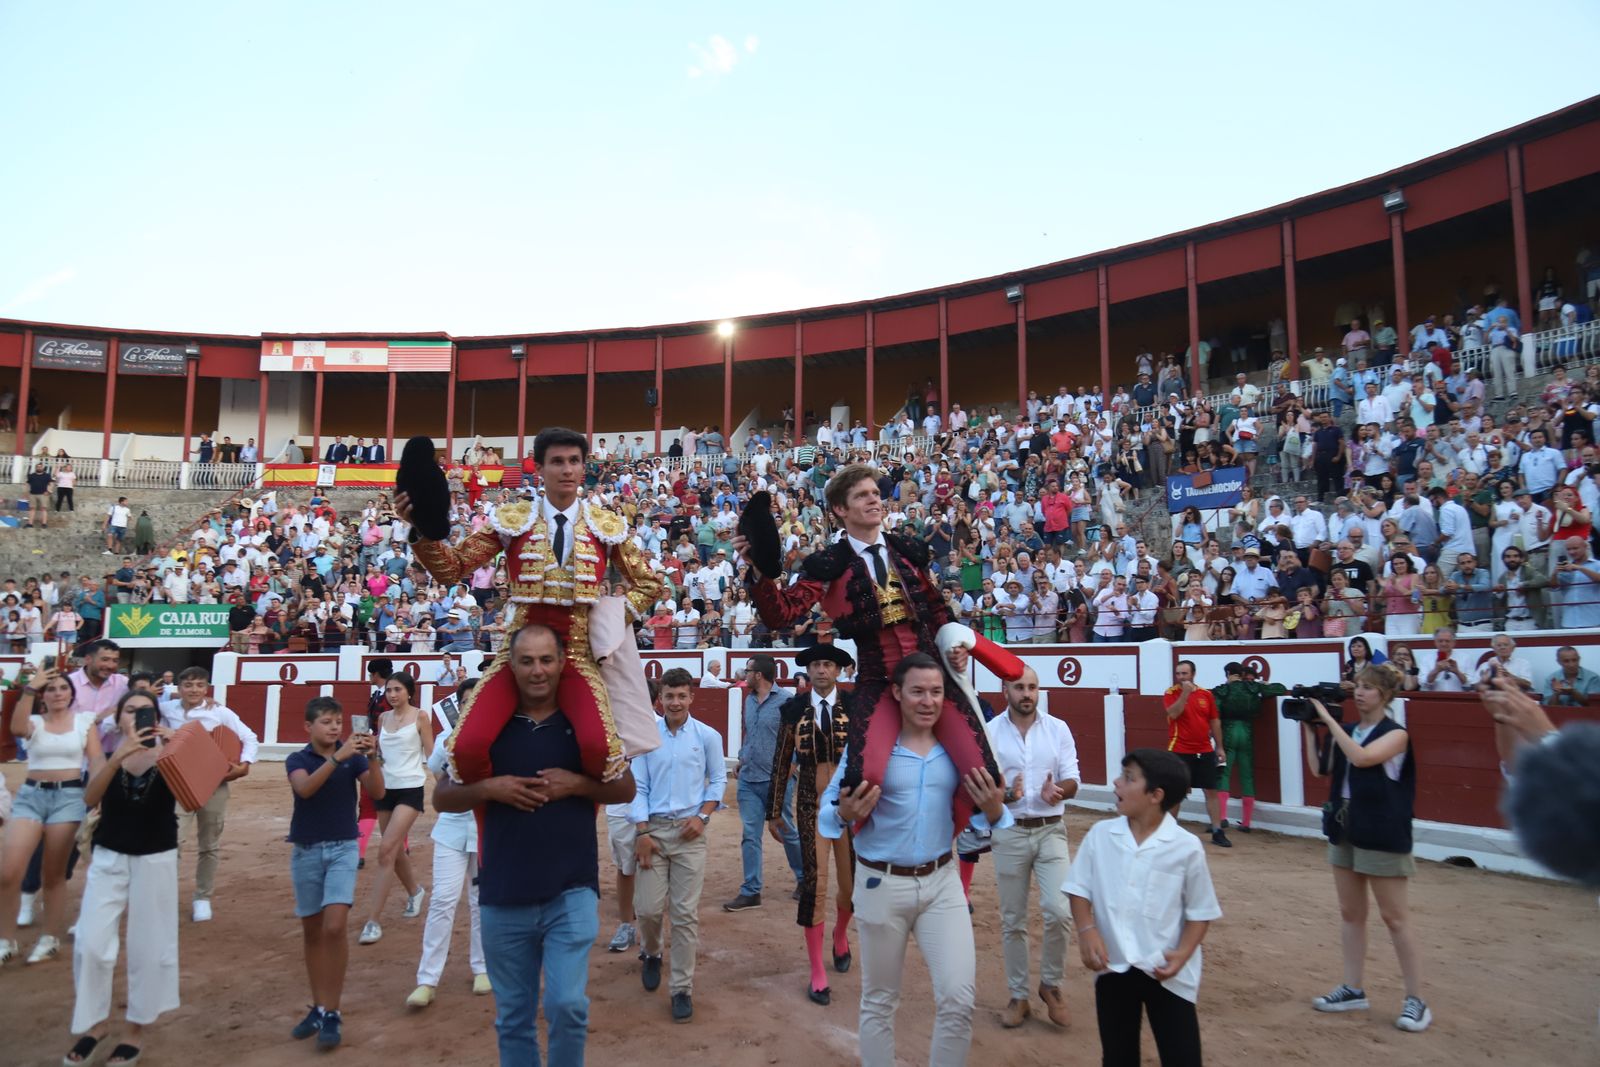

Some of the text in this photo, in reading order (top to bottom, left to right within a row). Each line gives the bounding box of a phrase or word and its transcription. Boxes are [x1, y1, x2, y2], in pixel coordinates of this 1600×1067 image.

[39, 341, 58, 356] La
[123, 347, 141, 362] La
[159, 612, 230, 625] CAJA RUR
[285, 665, 292, 680] 1
[650, 662, 657, 679] 1
[1063, 660, 1076, 682] 2
